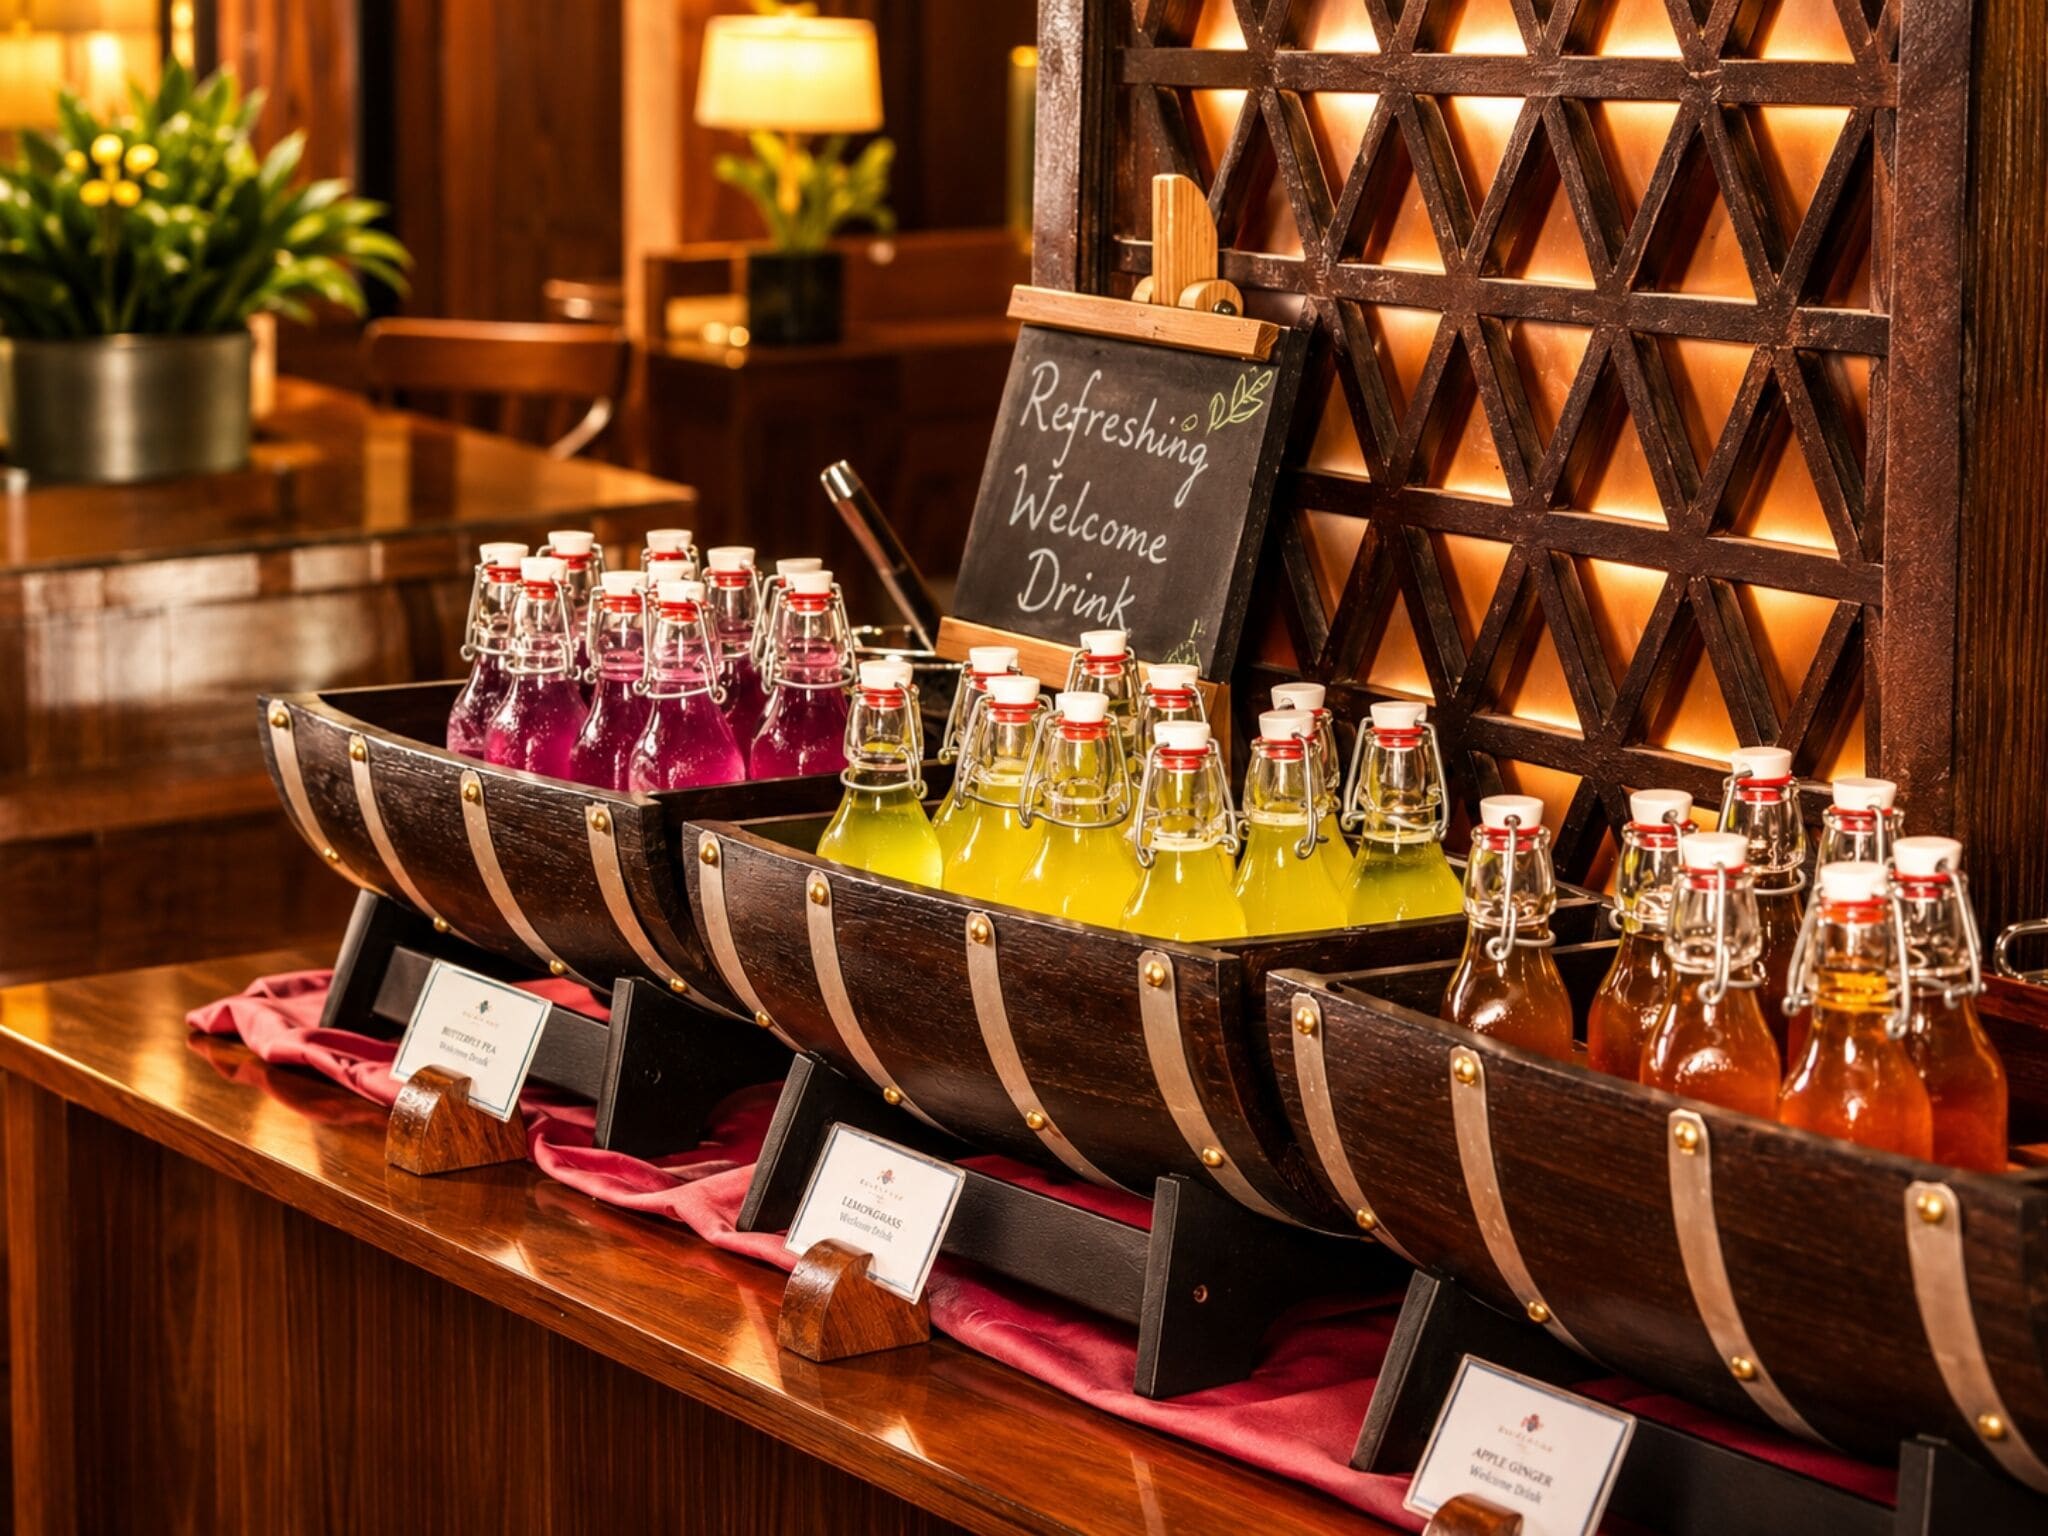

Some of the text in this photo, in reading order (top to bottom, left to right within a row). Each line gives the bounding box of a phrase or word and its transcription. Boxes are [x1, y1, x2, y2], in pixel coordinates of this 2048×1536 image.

[1020, 361, 1208, 508] Refreshing
[1009, 464, 1167, 564] Welcome
[1018, 548, 1135, 633] Drink
[441, 1026, 496, 1055] BUTTERFLY PEA
[841, 1196, 903, 1230] LEMONGRASS
[1469, 1464, 1543, 1504] Welcome Drink
[1472, 1447, 1554, 1487] APPLE GINGER
